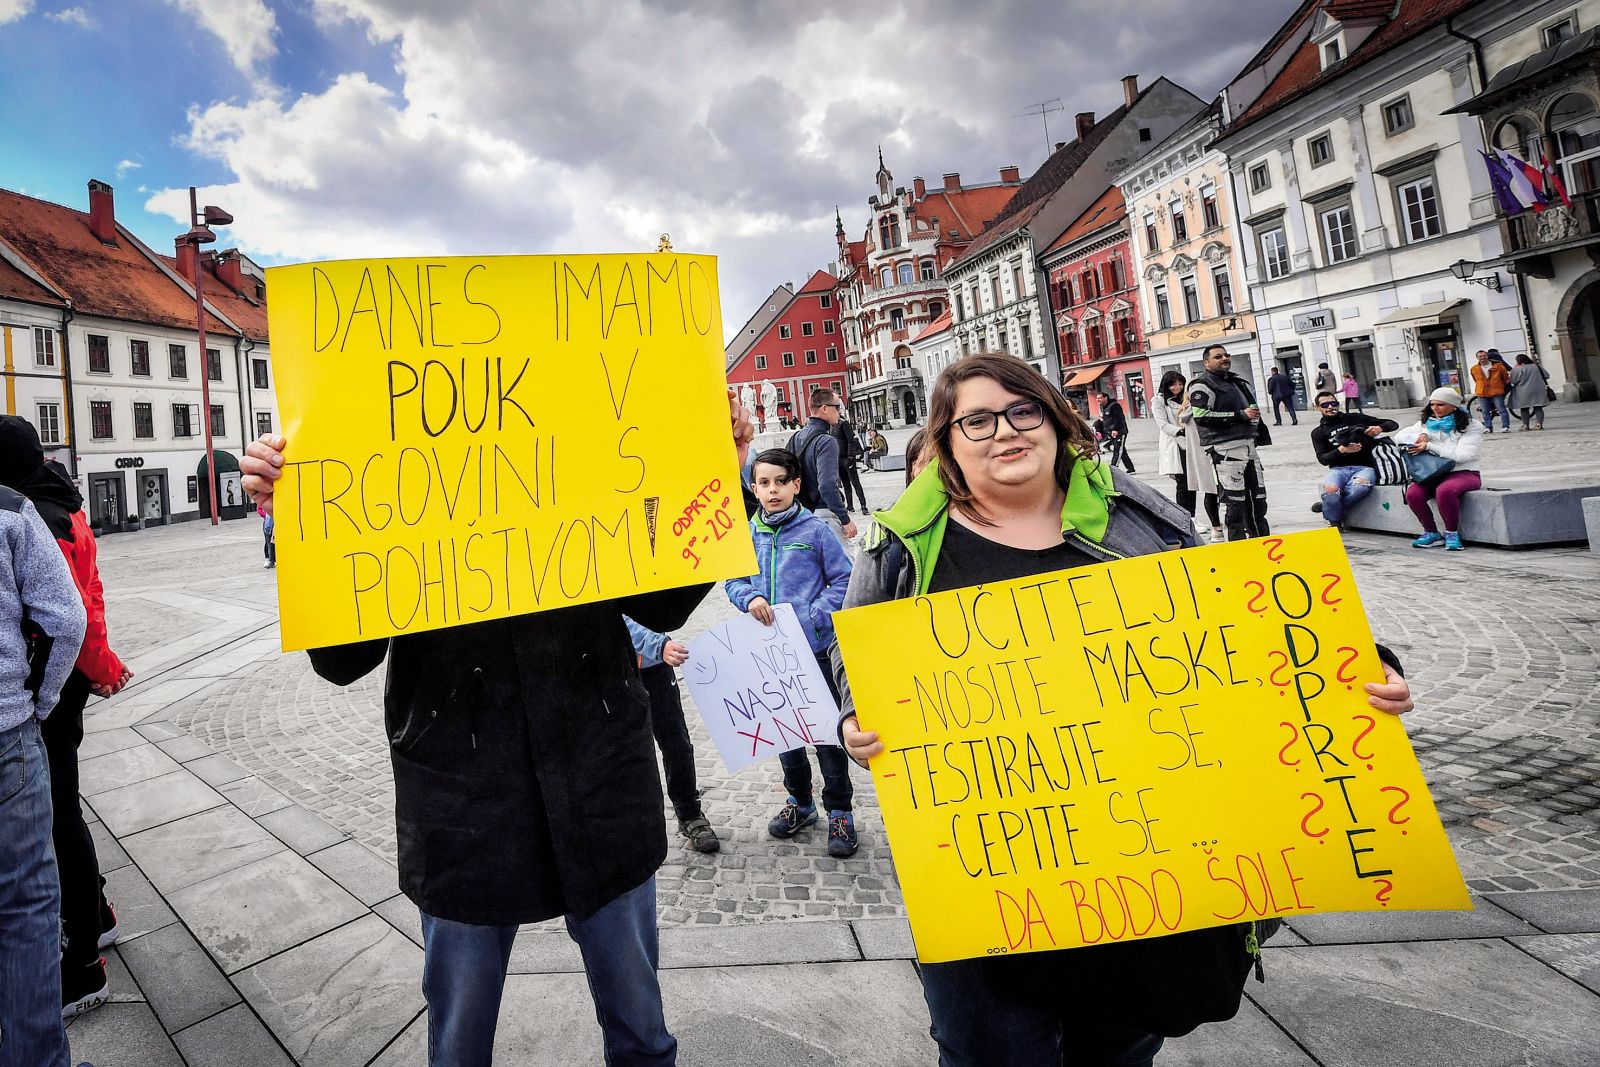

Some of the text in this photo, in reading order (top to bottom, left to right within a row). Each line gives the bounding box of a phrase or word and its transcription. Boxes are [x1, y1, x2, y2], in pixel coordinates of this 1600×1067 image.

[313, 259, 713, 353] DANES IMAMO
[387, 348, 640, 441] POUK V
[286, 426, 646, 542] TRGOVINI S
[672, 478, 721, 537] ODPRTO
[709, 624, 734, 654] V
[1084, 624, 1263, 708] MASKE,
[772, 706, 825, 749] NE
[1148, 703, 1223, 771] SE,
[1271, 571, 1394, 879] ODPRTE
[1060, 868, 1183, 944] BODO
[1207, 847, 1316, 920] ŠOLE
[75, 996, 102, 1012] FILA
